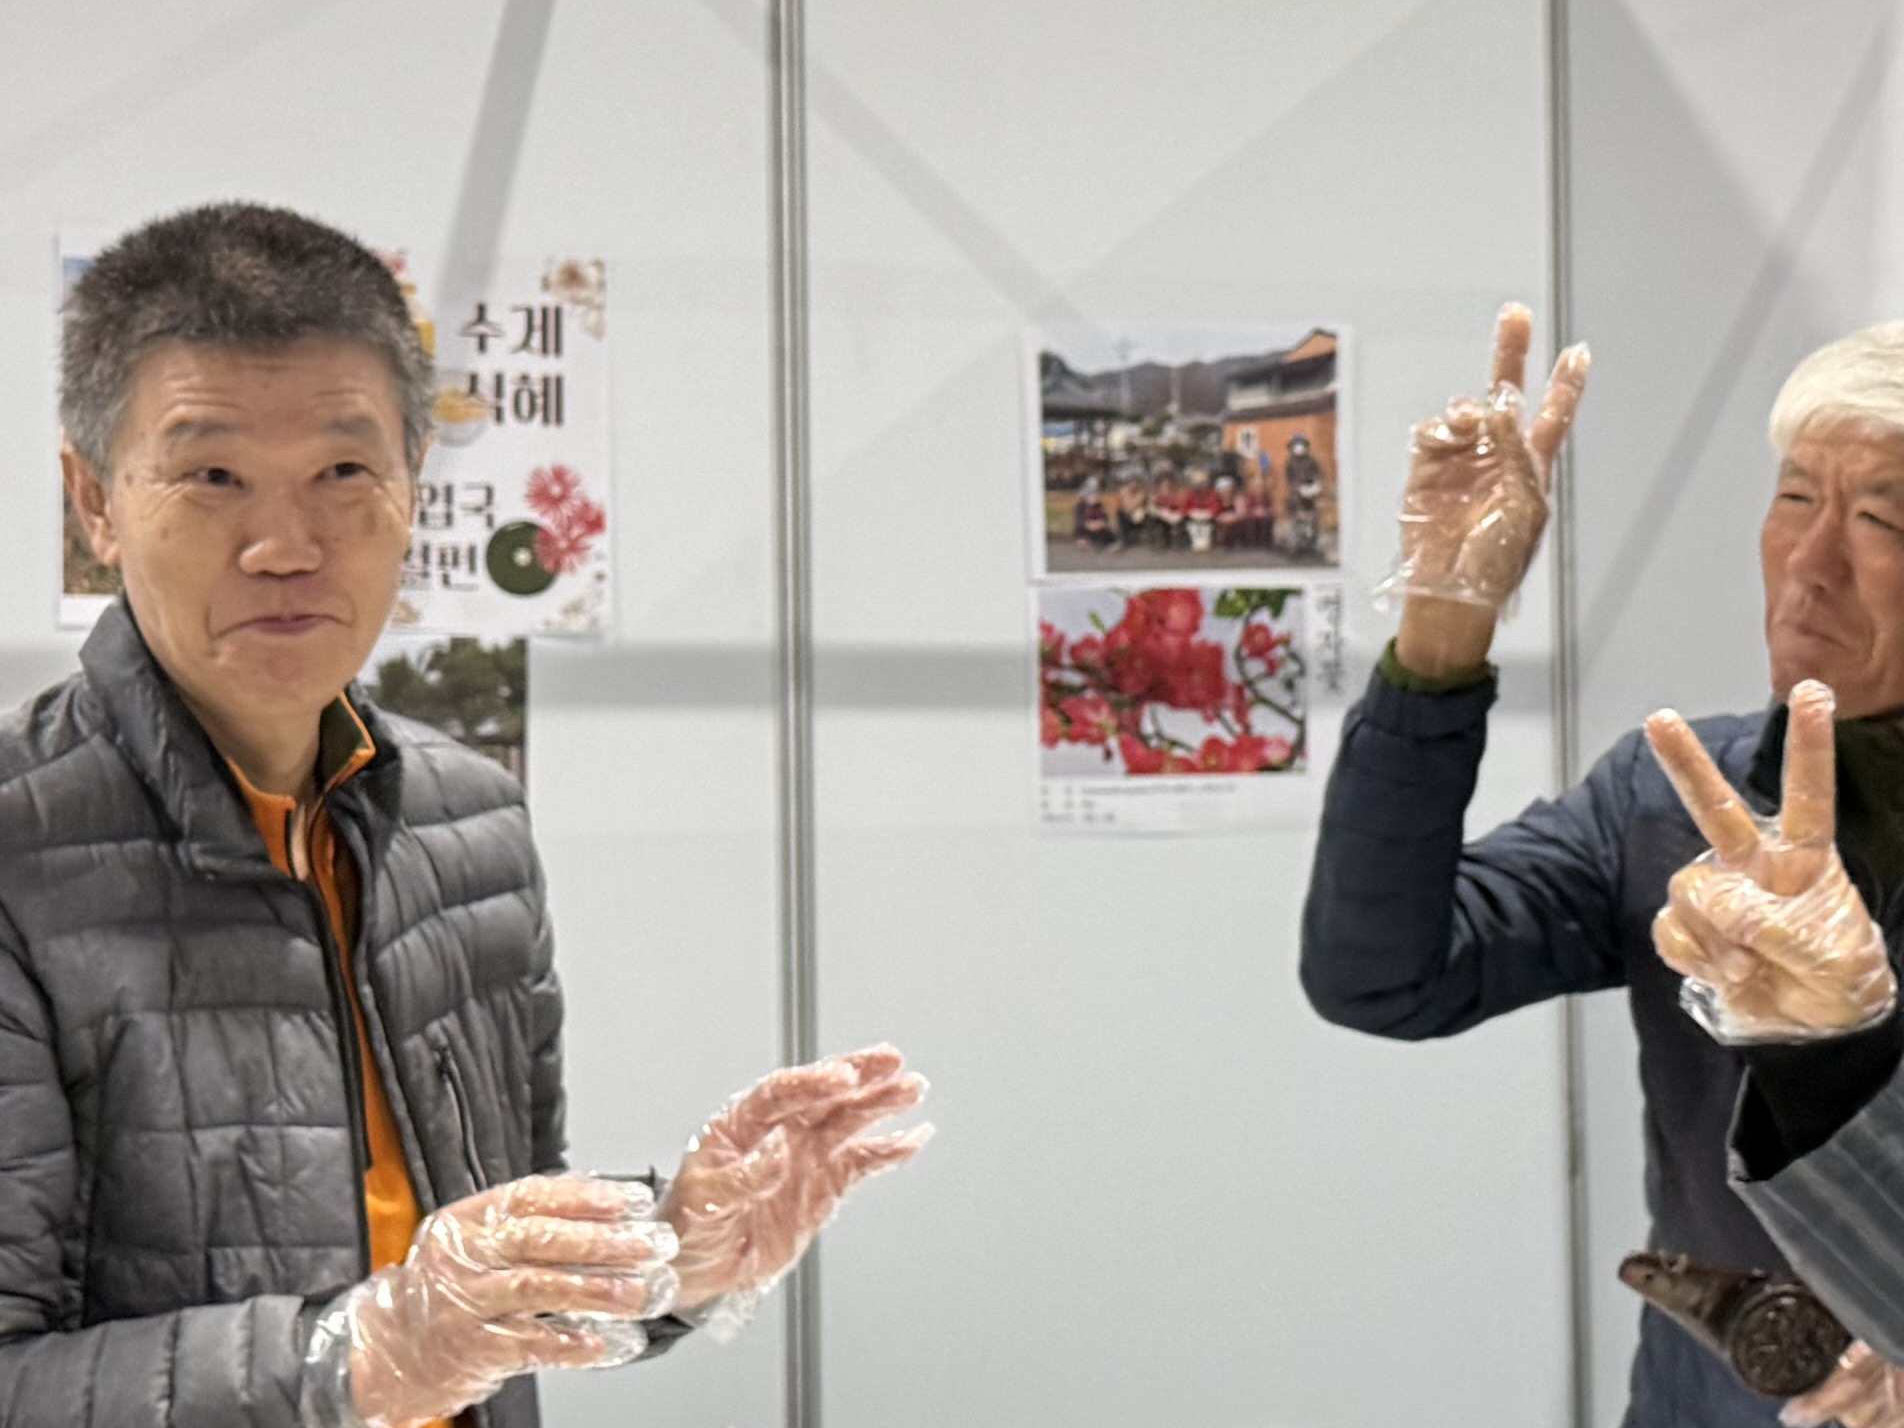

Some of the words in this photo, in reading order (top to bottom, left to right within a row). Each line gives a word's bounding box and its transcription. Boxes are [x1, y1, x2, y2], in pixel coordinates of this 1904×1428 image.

[460, 300, 564, 358] 수제
[462, 372, 564, 427] 식혜
[418, 482, 494, 530] 엽국
